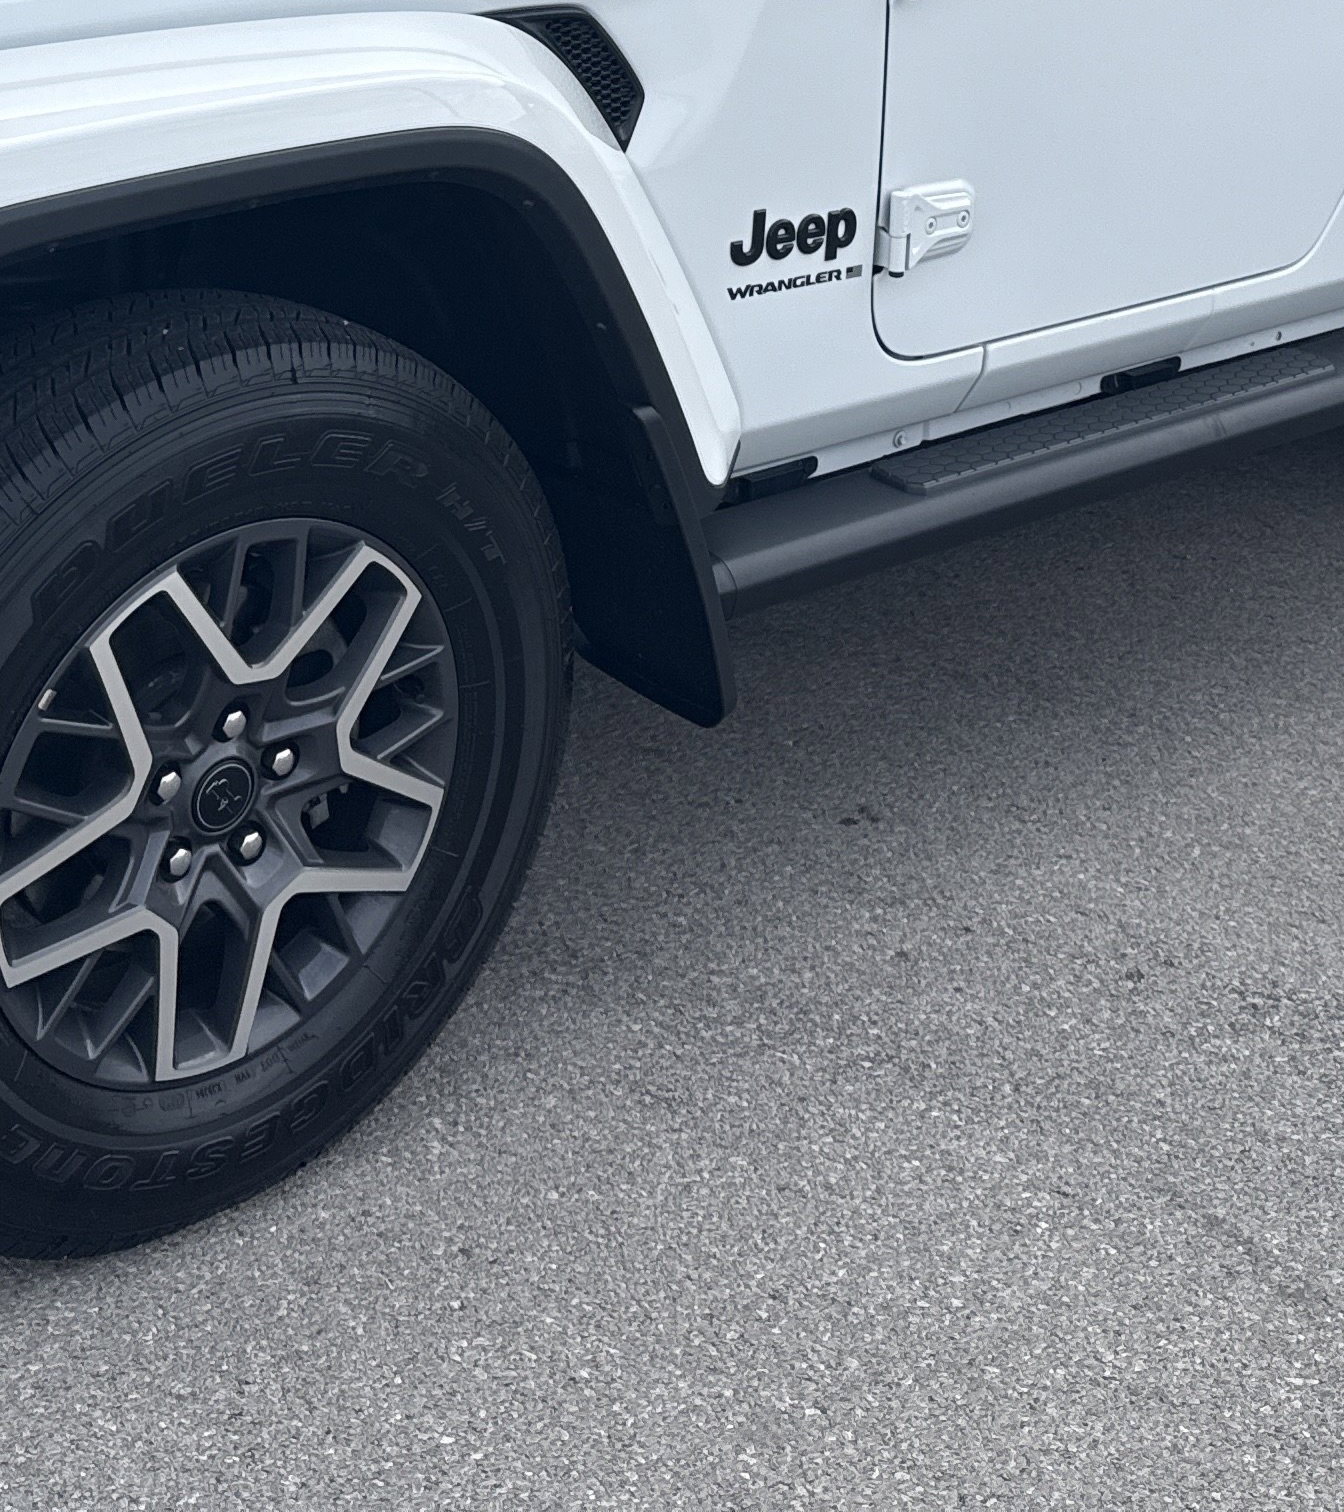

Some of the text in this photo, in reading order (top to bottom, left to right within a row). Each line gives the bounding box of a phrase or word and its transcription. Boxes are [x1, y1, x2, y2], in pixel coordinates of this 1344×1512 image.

[730, 207, 857, 266] Jeep
[727, 268, 842, 300] WRANGLER
[31, 428, 507, 630] DUELER H/T
